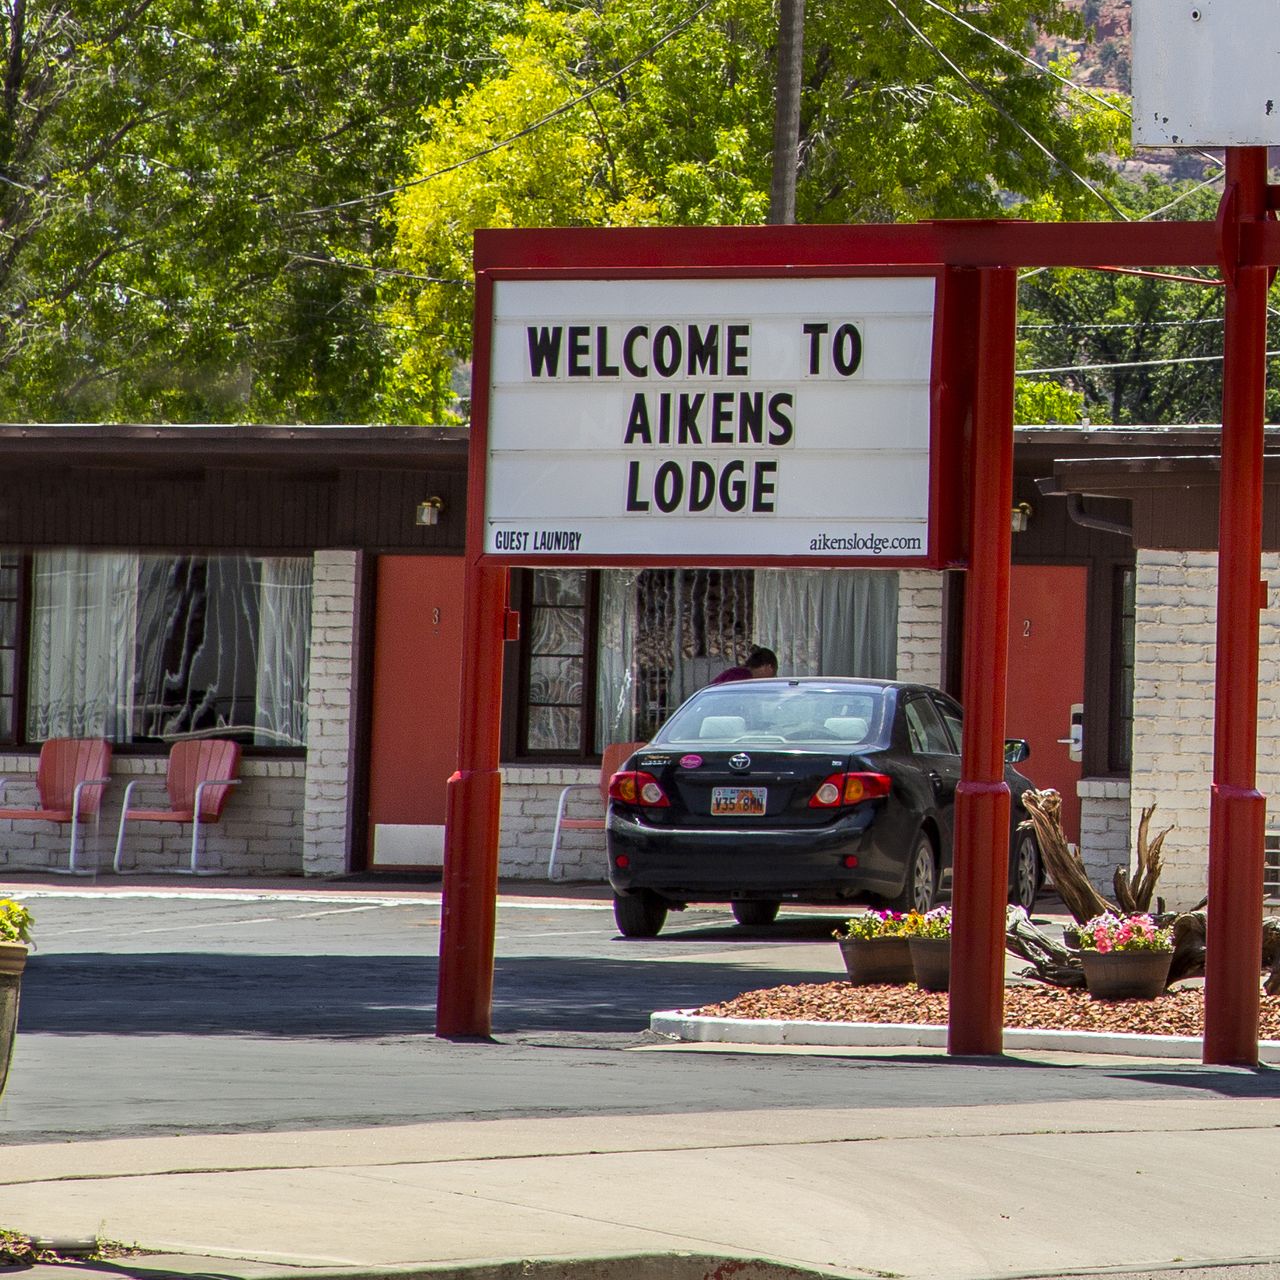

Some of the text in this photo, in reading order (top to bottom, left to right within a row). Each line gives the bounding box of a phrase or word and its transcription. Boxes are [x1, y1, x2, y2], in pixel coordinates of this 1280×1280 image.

[527, 323, 862, 378] WELCOME TO
[624, 392, 794, 446] AIKENS
[626, 459, 778, 513] LODGE
[495, 531, 582, 551] GUEST LAUNDRY
[809, 532, 922, 554] aikenslodge.com
[432, 607, 440, 625] 3
[1023, 620, 1030, 637] 2
